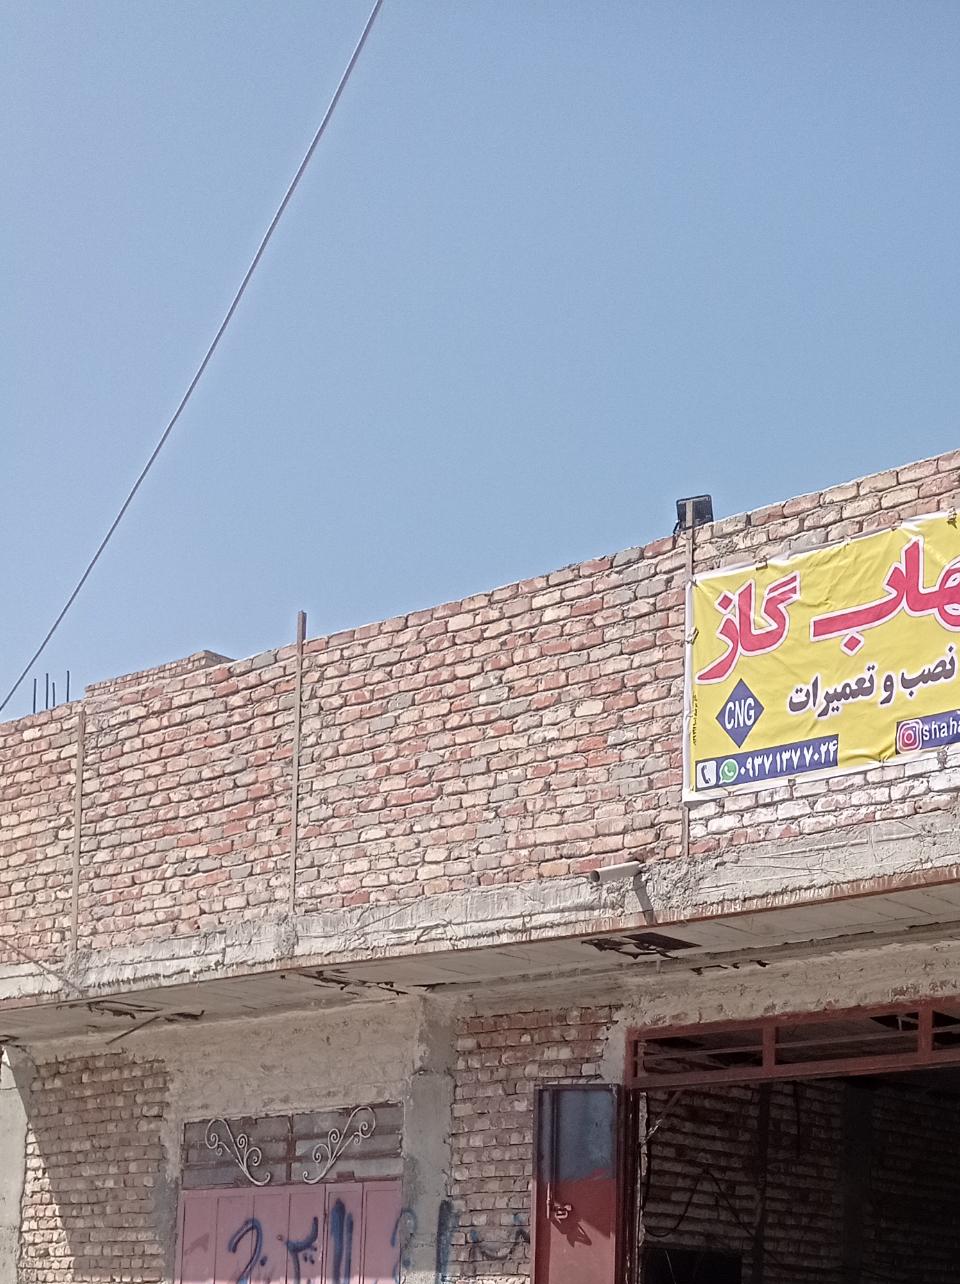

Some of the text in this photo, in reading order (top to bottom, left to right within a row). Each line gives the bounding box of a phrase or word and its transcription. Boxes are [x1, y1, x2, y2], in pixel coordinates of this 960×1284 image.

[696, 573, 800, 682] گاز
[724, 697, 756, 729] CNG
[788, 646, 957, 718] نصب و تعمیرات
